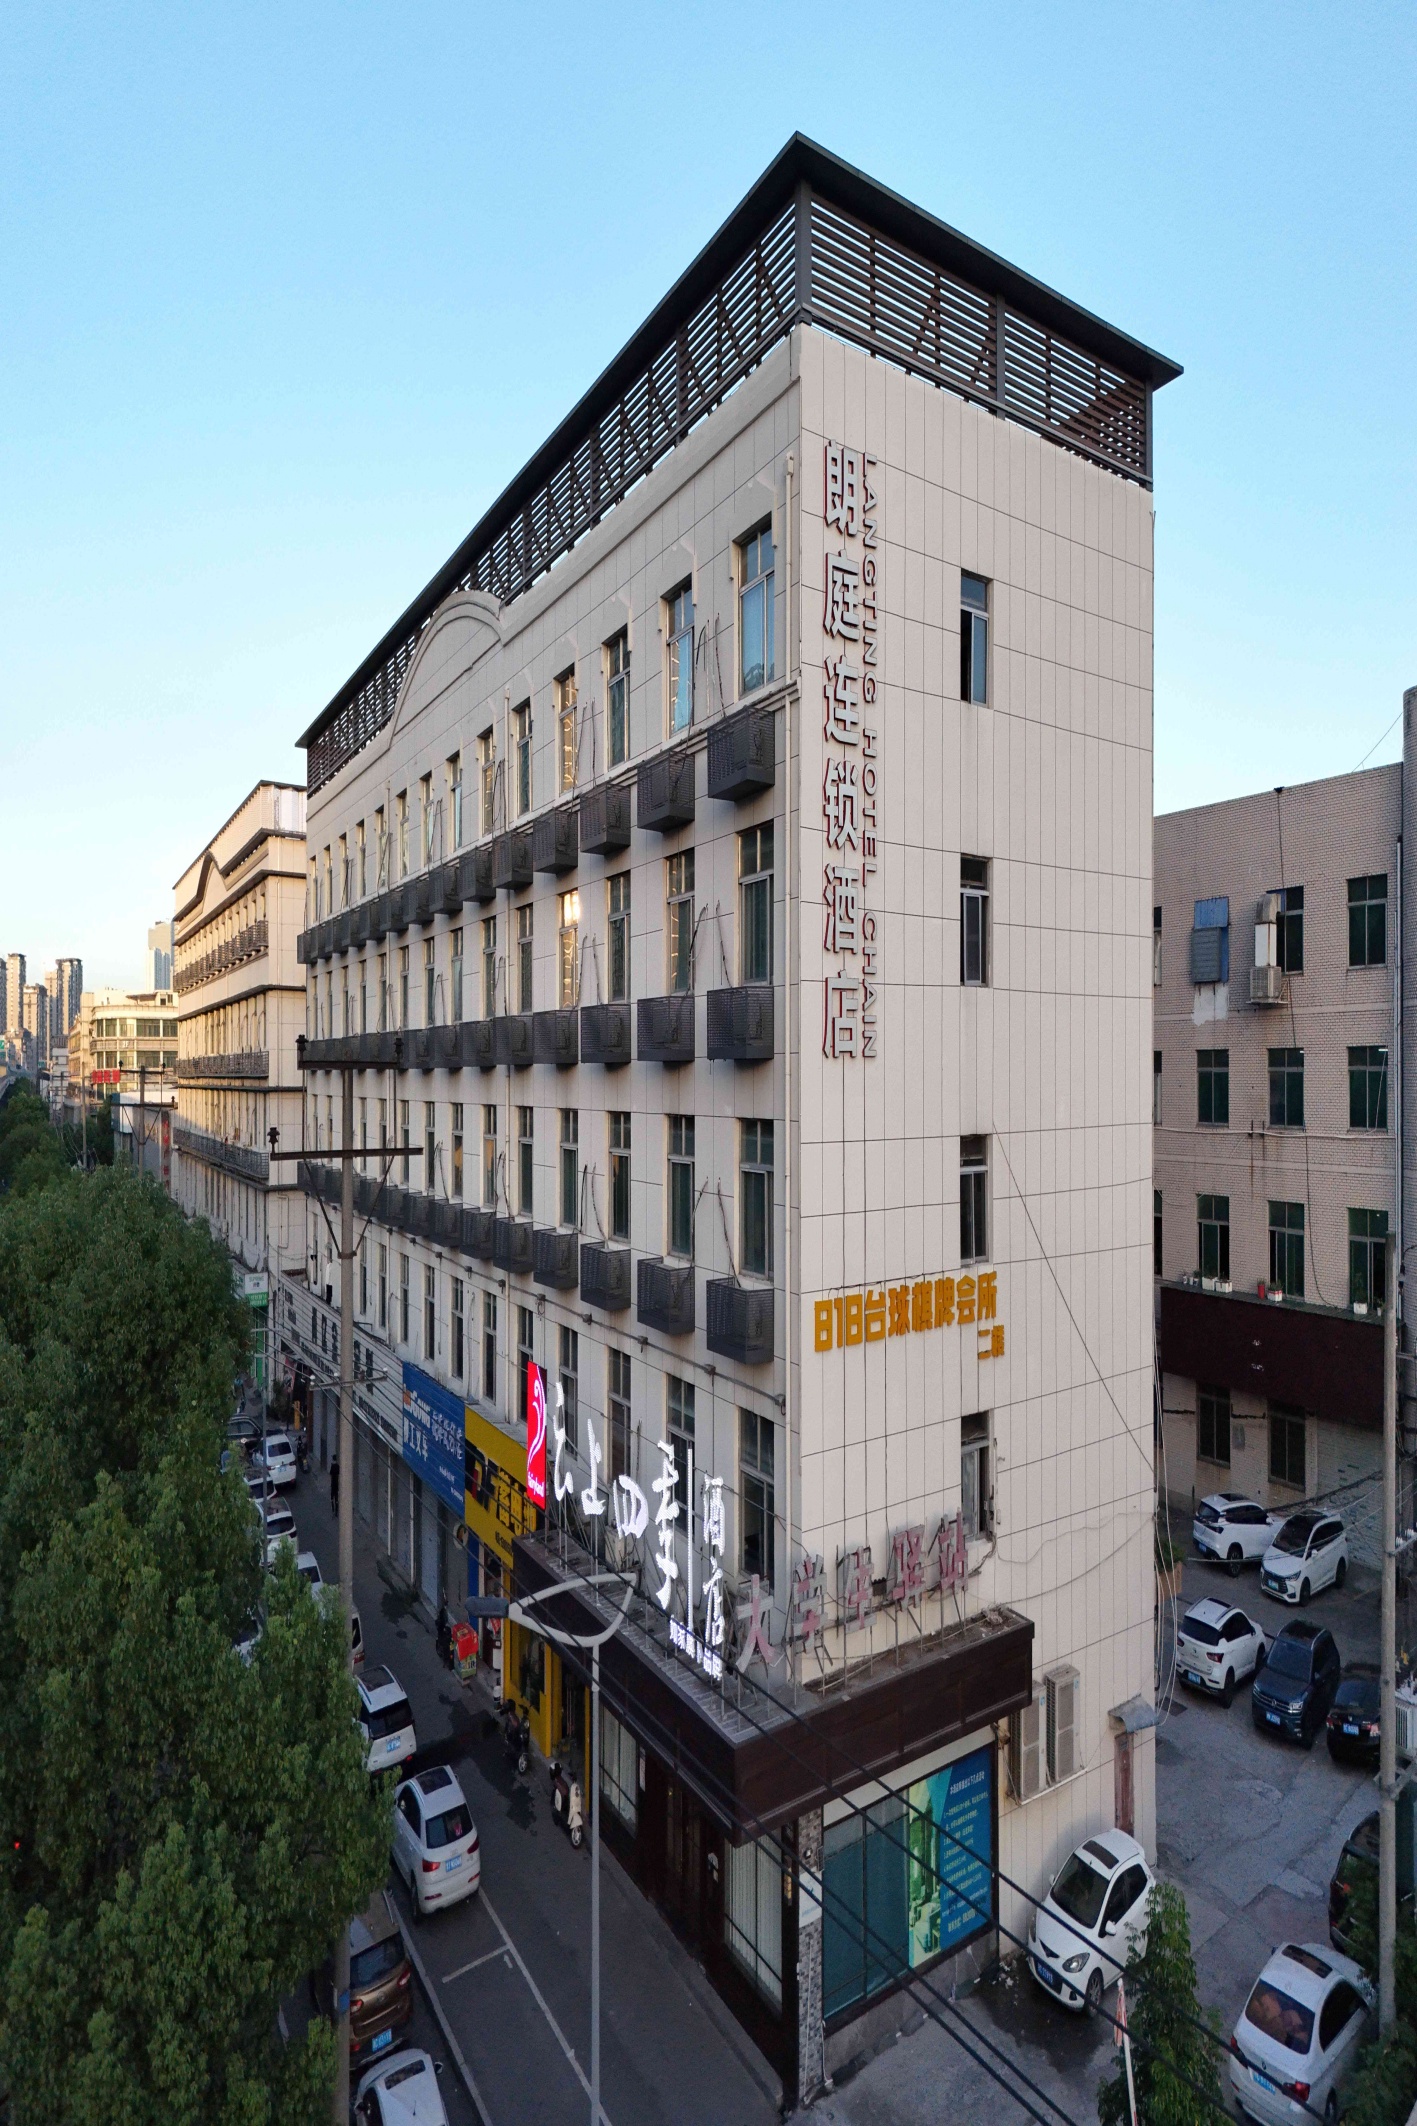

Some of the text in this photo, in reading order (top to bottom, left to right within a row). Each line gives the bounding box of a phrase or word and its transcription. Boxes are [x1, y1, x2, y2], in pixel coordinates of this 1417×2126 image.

[824, 439, 860, 1058] 朗庭连锁酒店
[862, 452, 878, 1058] LANGTING HOTEL CHAIN
[814, 1271, 997, 1352] 818台球棋牌会所
[978, 1324, 1005, 1360] 二楼
[527, 1471, 545, 1498] fairyland
